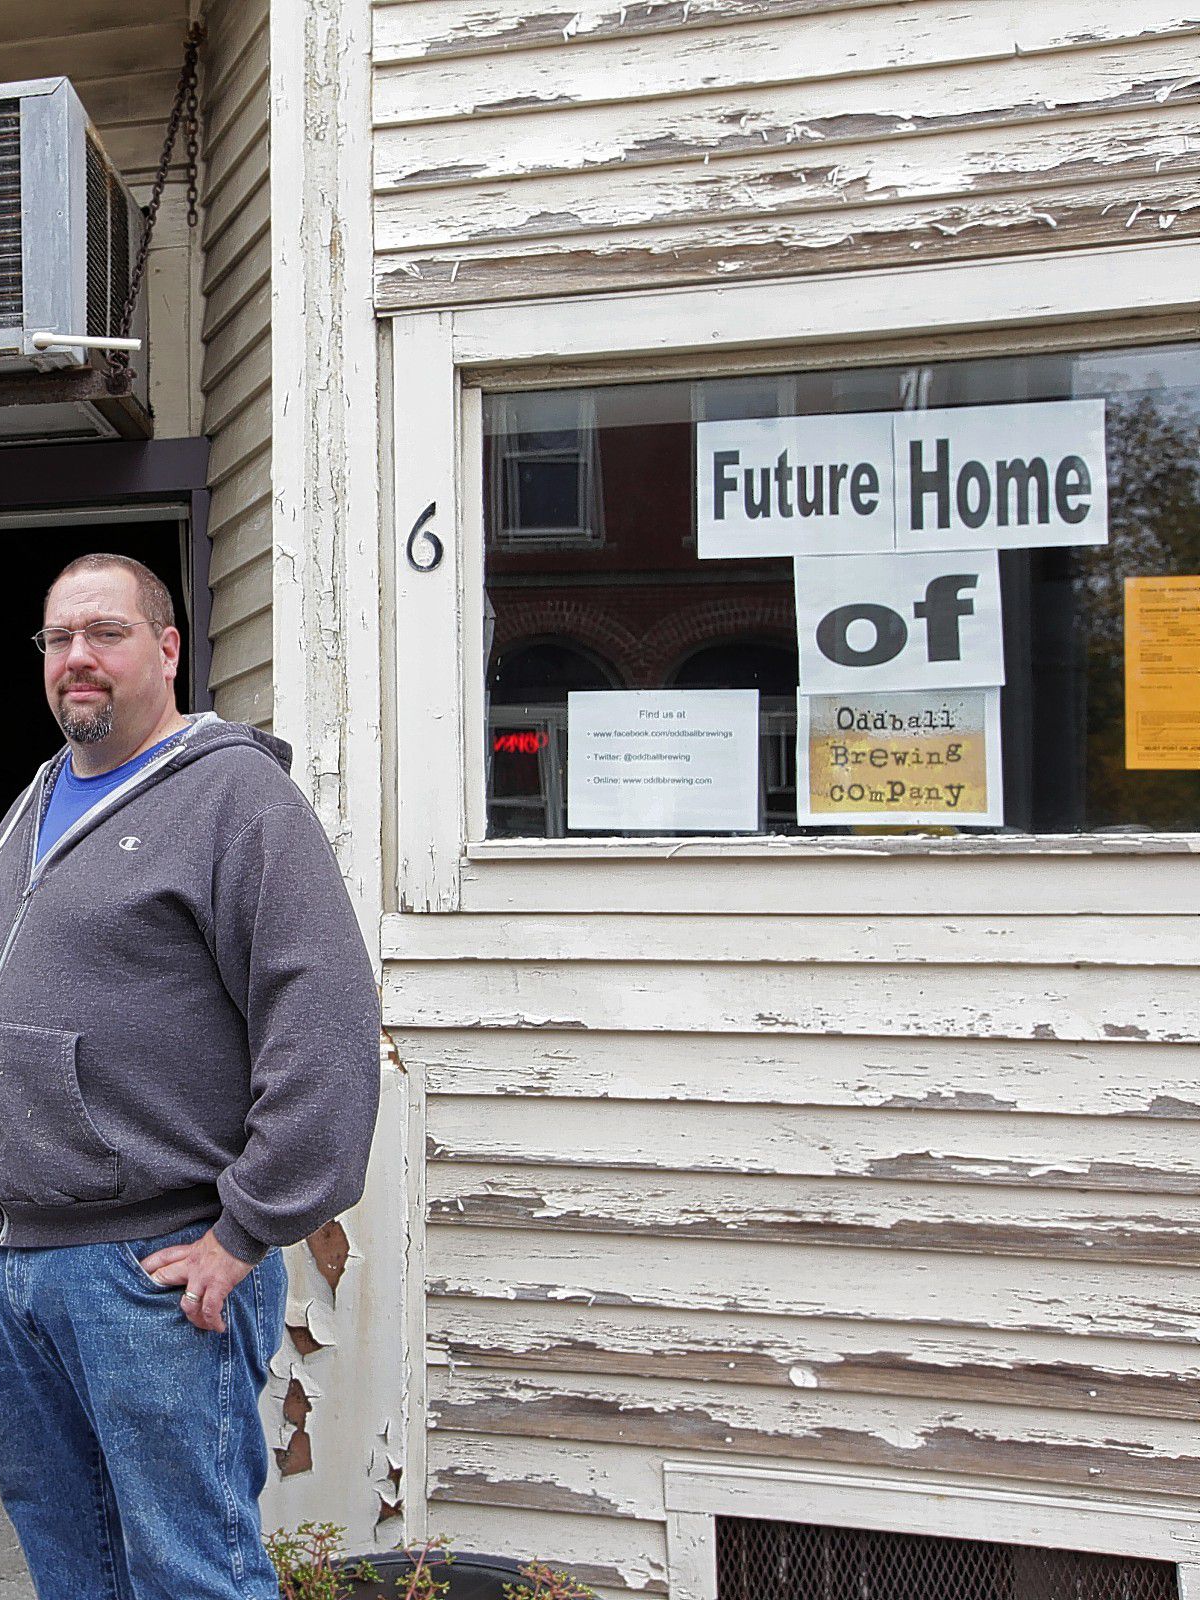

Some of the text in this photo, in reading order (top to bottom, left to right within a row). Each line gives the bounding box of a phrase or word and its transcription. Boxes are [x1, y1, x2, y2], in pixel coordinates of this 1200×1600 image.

[713, 438, 1092, 530] Future Home
[406, 501, 444, 573] 6
[815, 574, 979, 667] of
[639, 710, 687, 720] Find us at
[836, 706, 955, 731] Oddball
[830, 743, 963, 768] Brewing
